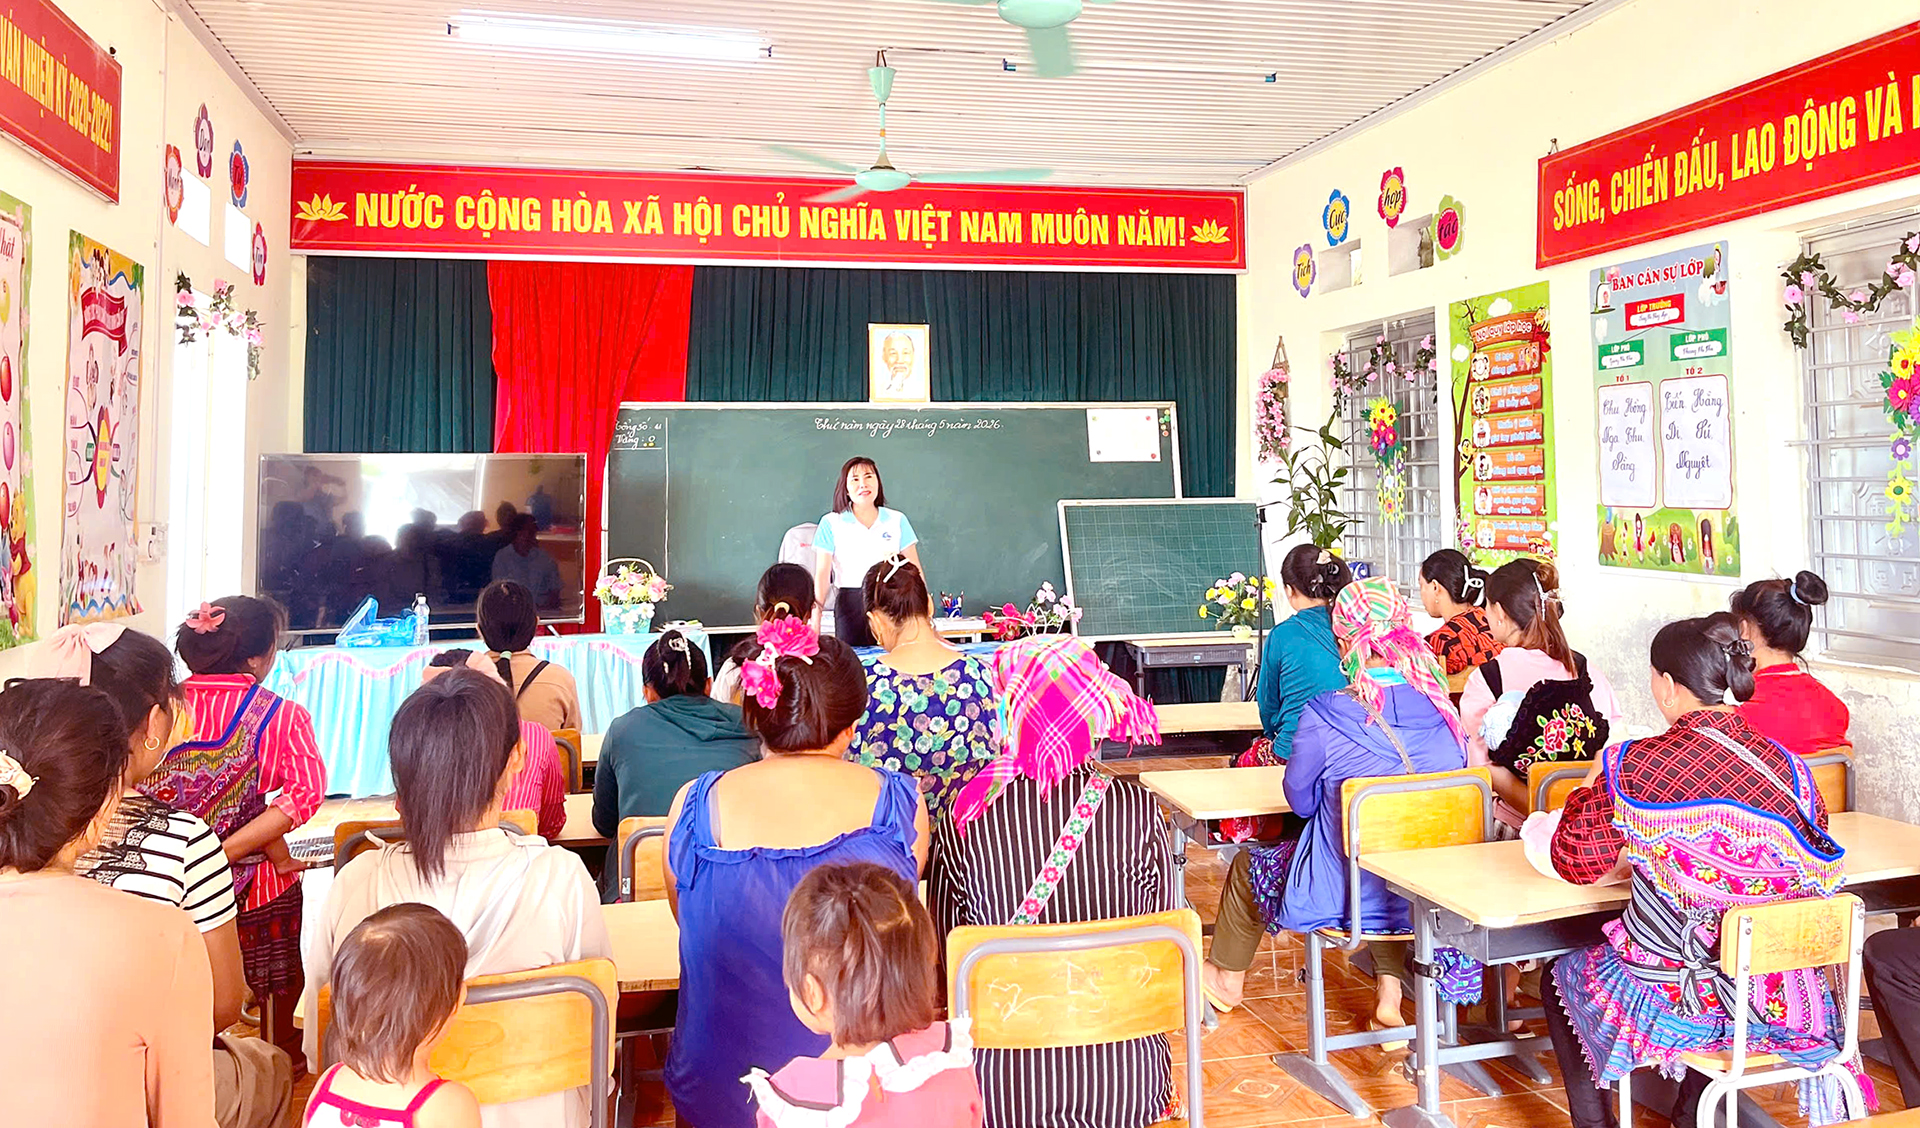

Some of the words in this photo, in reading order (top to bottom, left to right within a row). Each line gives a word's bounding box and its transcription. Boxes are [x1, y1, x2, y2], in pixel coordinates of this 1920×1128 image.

[23, 36, 54, 118] NHIỆM
[56, 54, 68, 121] KỲ
[1553, 170, 1605, 231] SỐNG,
[1610, 145, 1668, 215] CHIẾN
[1674, 128, 1724, 196] ĐẤU,
[1731, 122, 1775, 181] LAO
[1783, 96, 1856, 172] ĐỘNG
[1865, 72, 1903, 141] VÀ
[355, 184, 444, 228] NƯỚC
[455, 190, 541, 238] CỘNG
[552, 191, 613, 234] HÒA
[623, 196, 664, 235] XÃ
[673, 196, 722, 244] HỘI
[732, 193, 790, 238] CHỦ
[800, 202, 884, 241] NGHĨA
[894, 205, 952, 249] VIỆT
[960, 213, 1022, 244] NAM
[1032, 207, 1114, 246] MUÔN
[1118, 210, 1186, 247] NĂM!
[1438, 215, 1458, 242] tác
[0, 228, 15, 262] hật
[1612, 275, 1634, 292] BAN
[1637, 268, 1660, 286] CÁN
[1663, 263, 1678, 283] SỰ
[1680, 258, 1704, 278] LỚP
[815, 418, 840, 430] Thứ
[866, 419, 894, 438] ngày
[895, 419, 906, 429] 28
[906, 418, 937, 437] tháng
[939, 419, 946, 429] 5
[1676, 450, 1711, 479] Nguyệt
